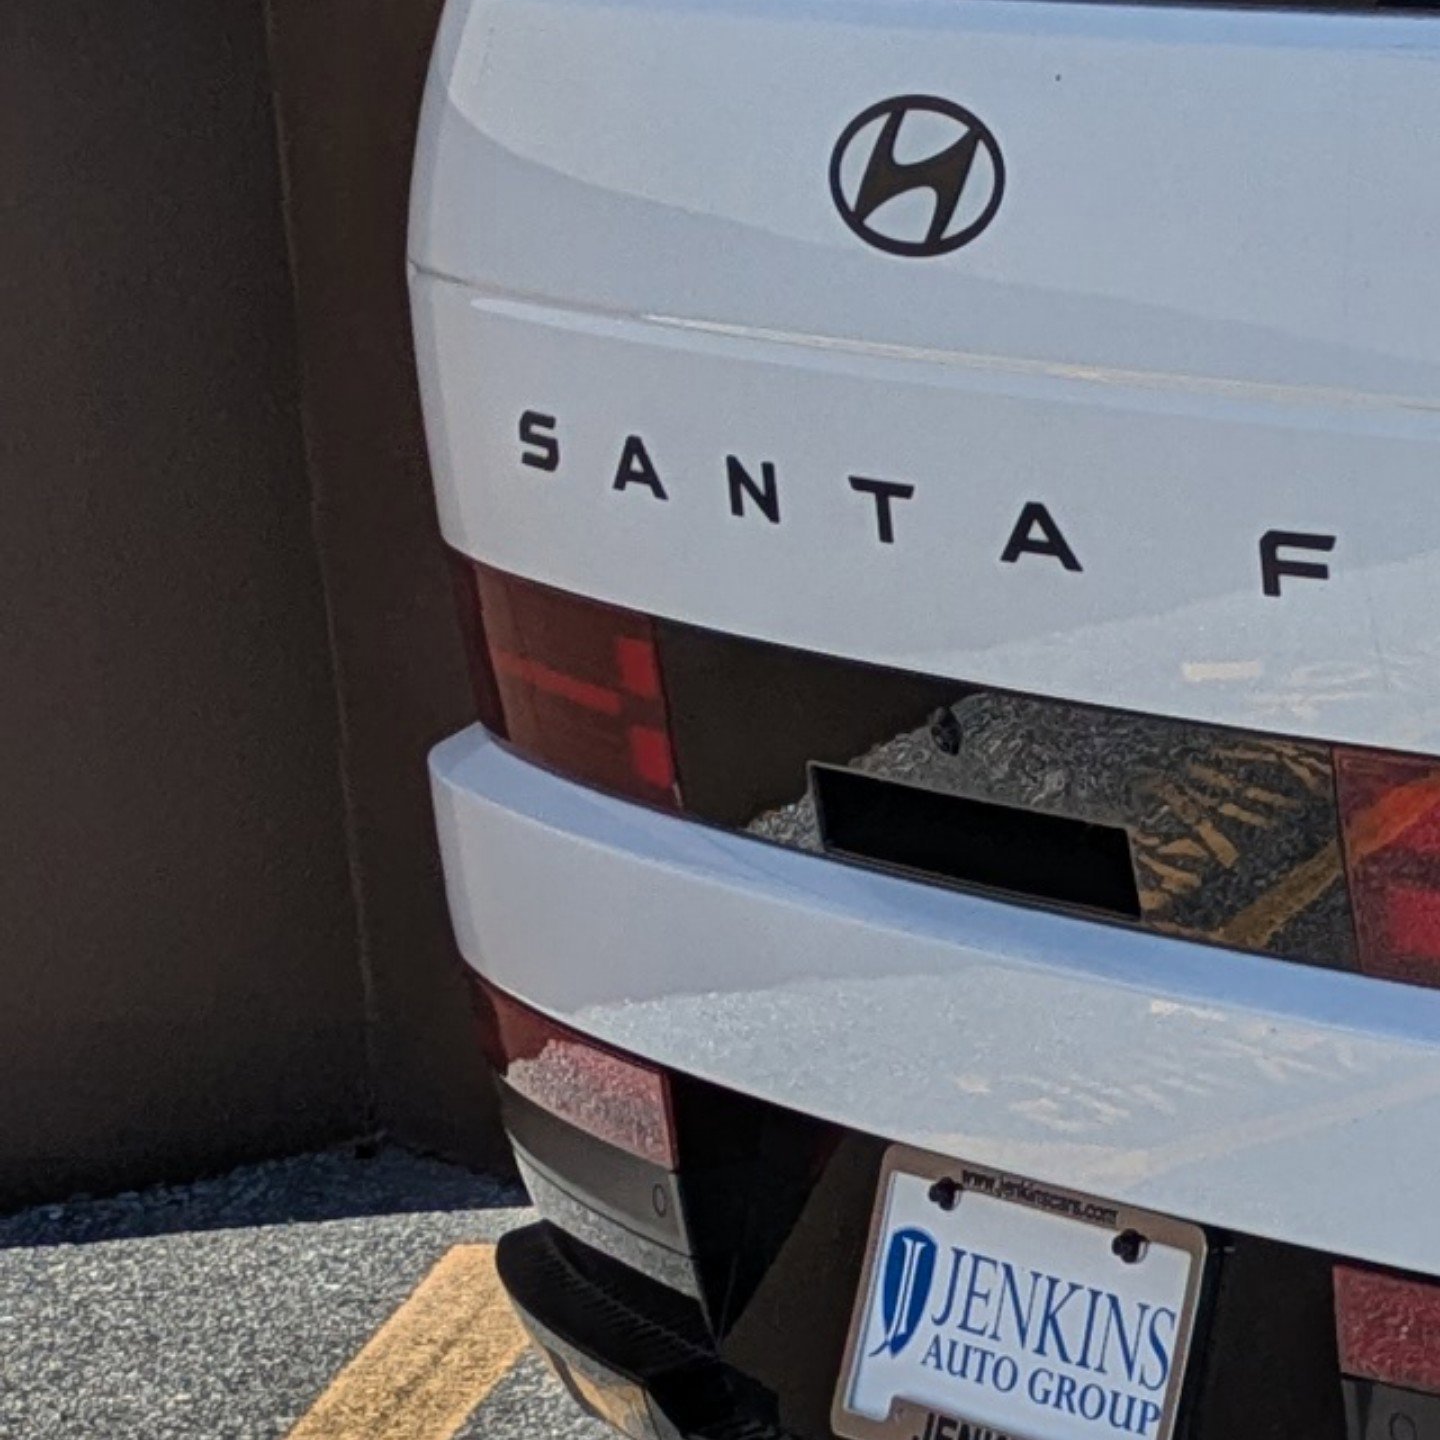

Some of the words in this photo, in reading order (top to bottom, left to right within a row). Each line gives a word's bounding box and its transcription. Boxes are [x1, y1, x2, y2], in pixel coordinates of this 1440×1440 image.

[518, 409, 1084, 573] SANTA
[920, 1333, 1019, 1394] AUTO
[1028, 1367, 1163, 1437] GROUP
[931, 1246, 1177, 1391] JENKINS
